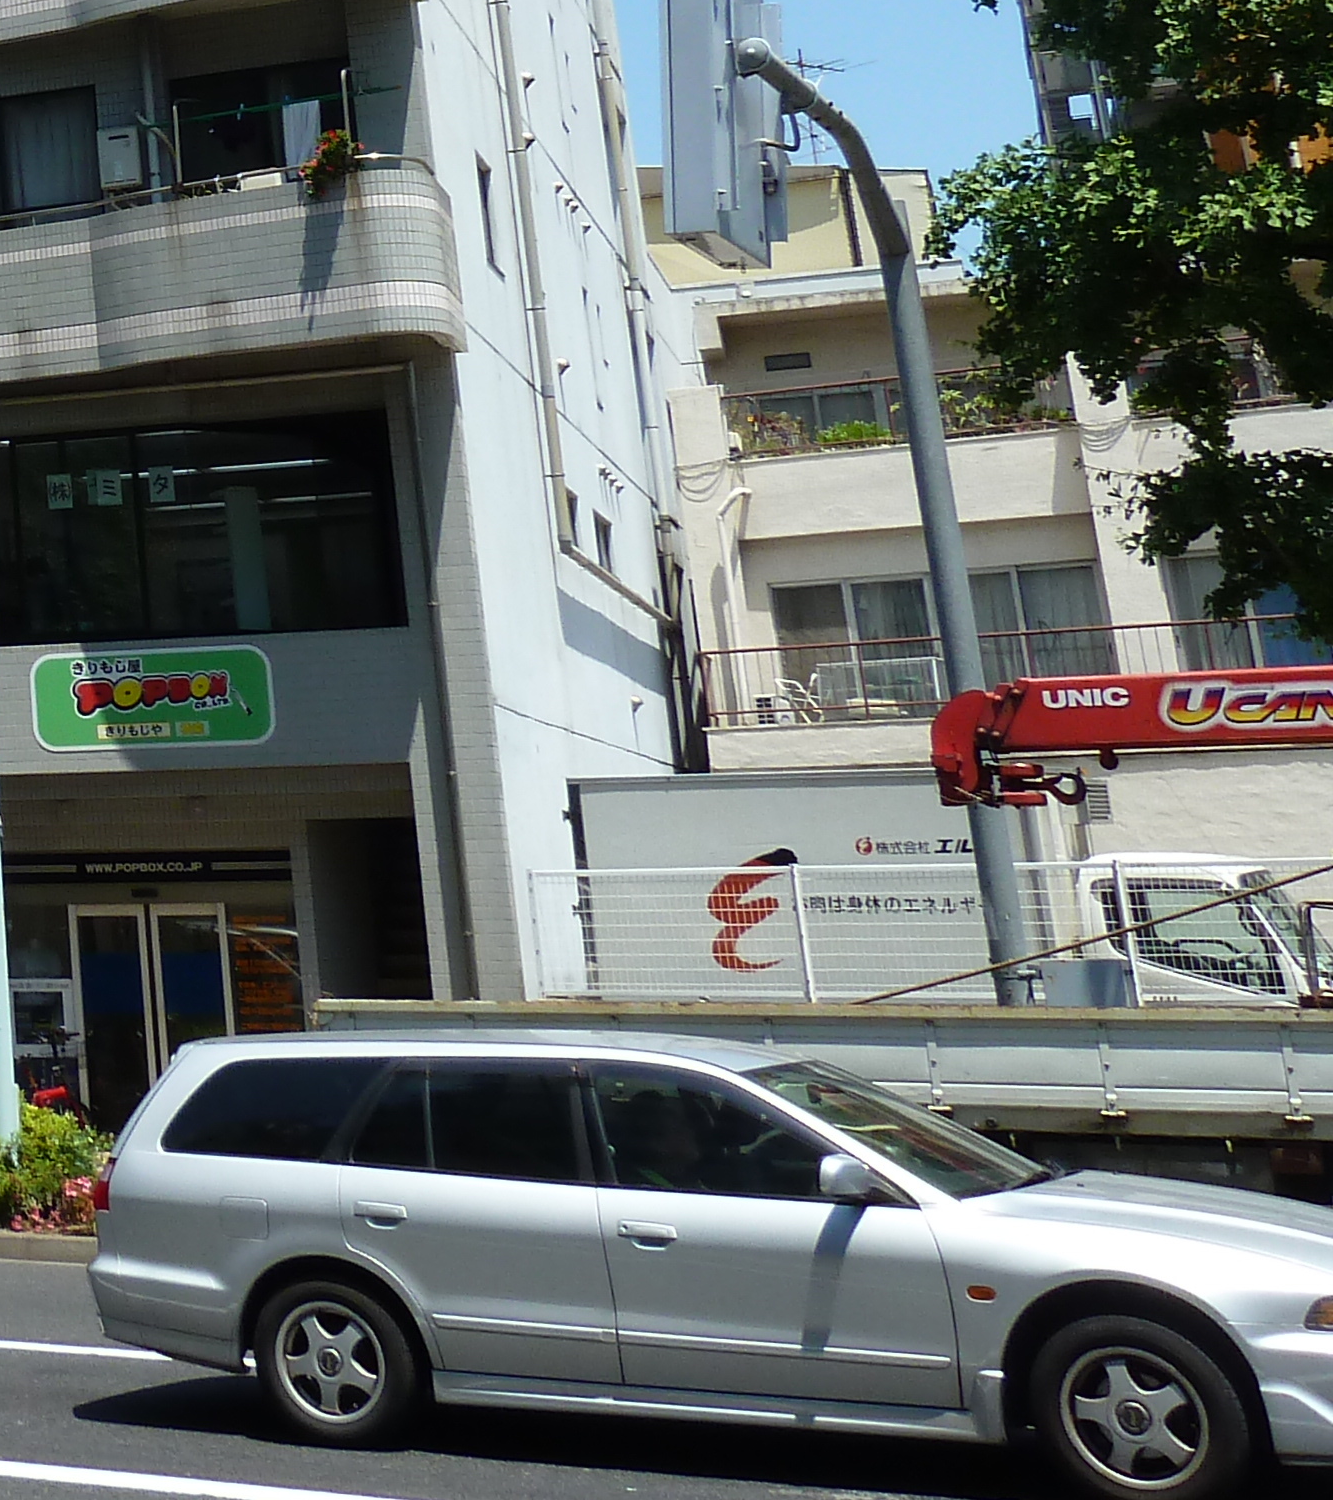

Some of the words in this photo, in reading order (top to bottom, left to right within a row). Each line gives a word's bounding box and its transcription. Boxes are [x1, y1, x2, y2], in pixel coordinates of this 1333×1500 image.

[71, 659, 142, 675] きりもじ屋
[71, 670, 230, 717] POPBOX
[1041, 686, 1130, 710] UNIC
[105, 724, 163, 738] きりもじや
[84, 861, 203, 874] WWW.POPBOX.CO.JP
